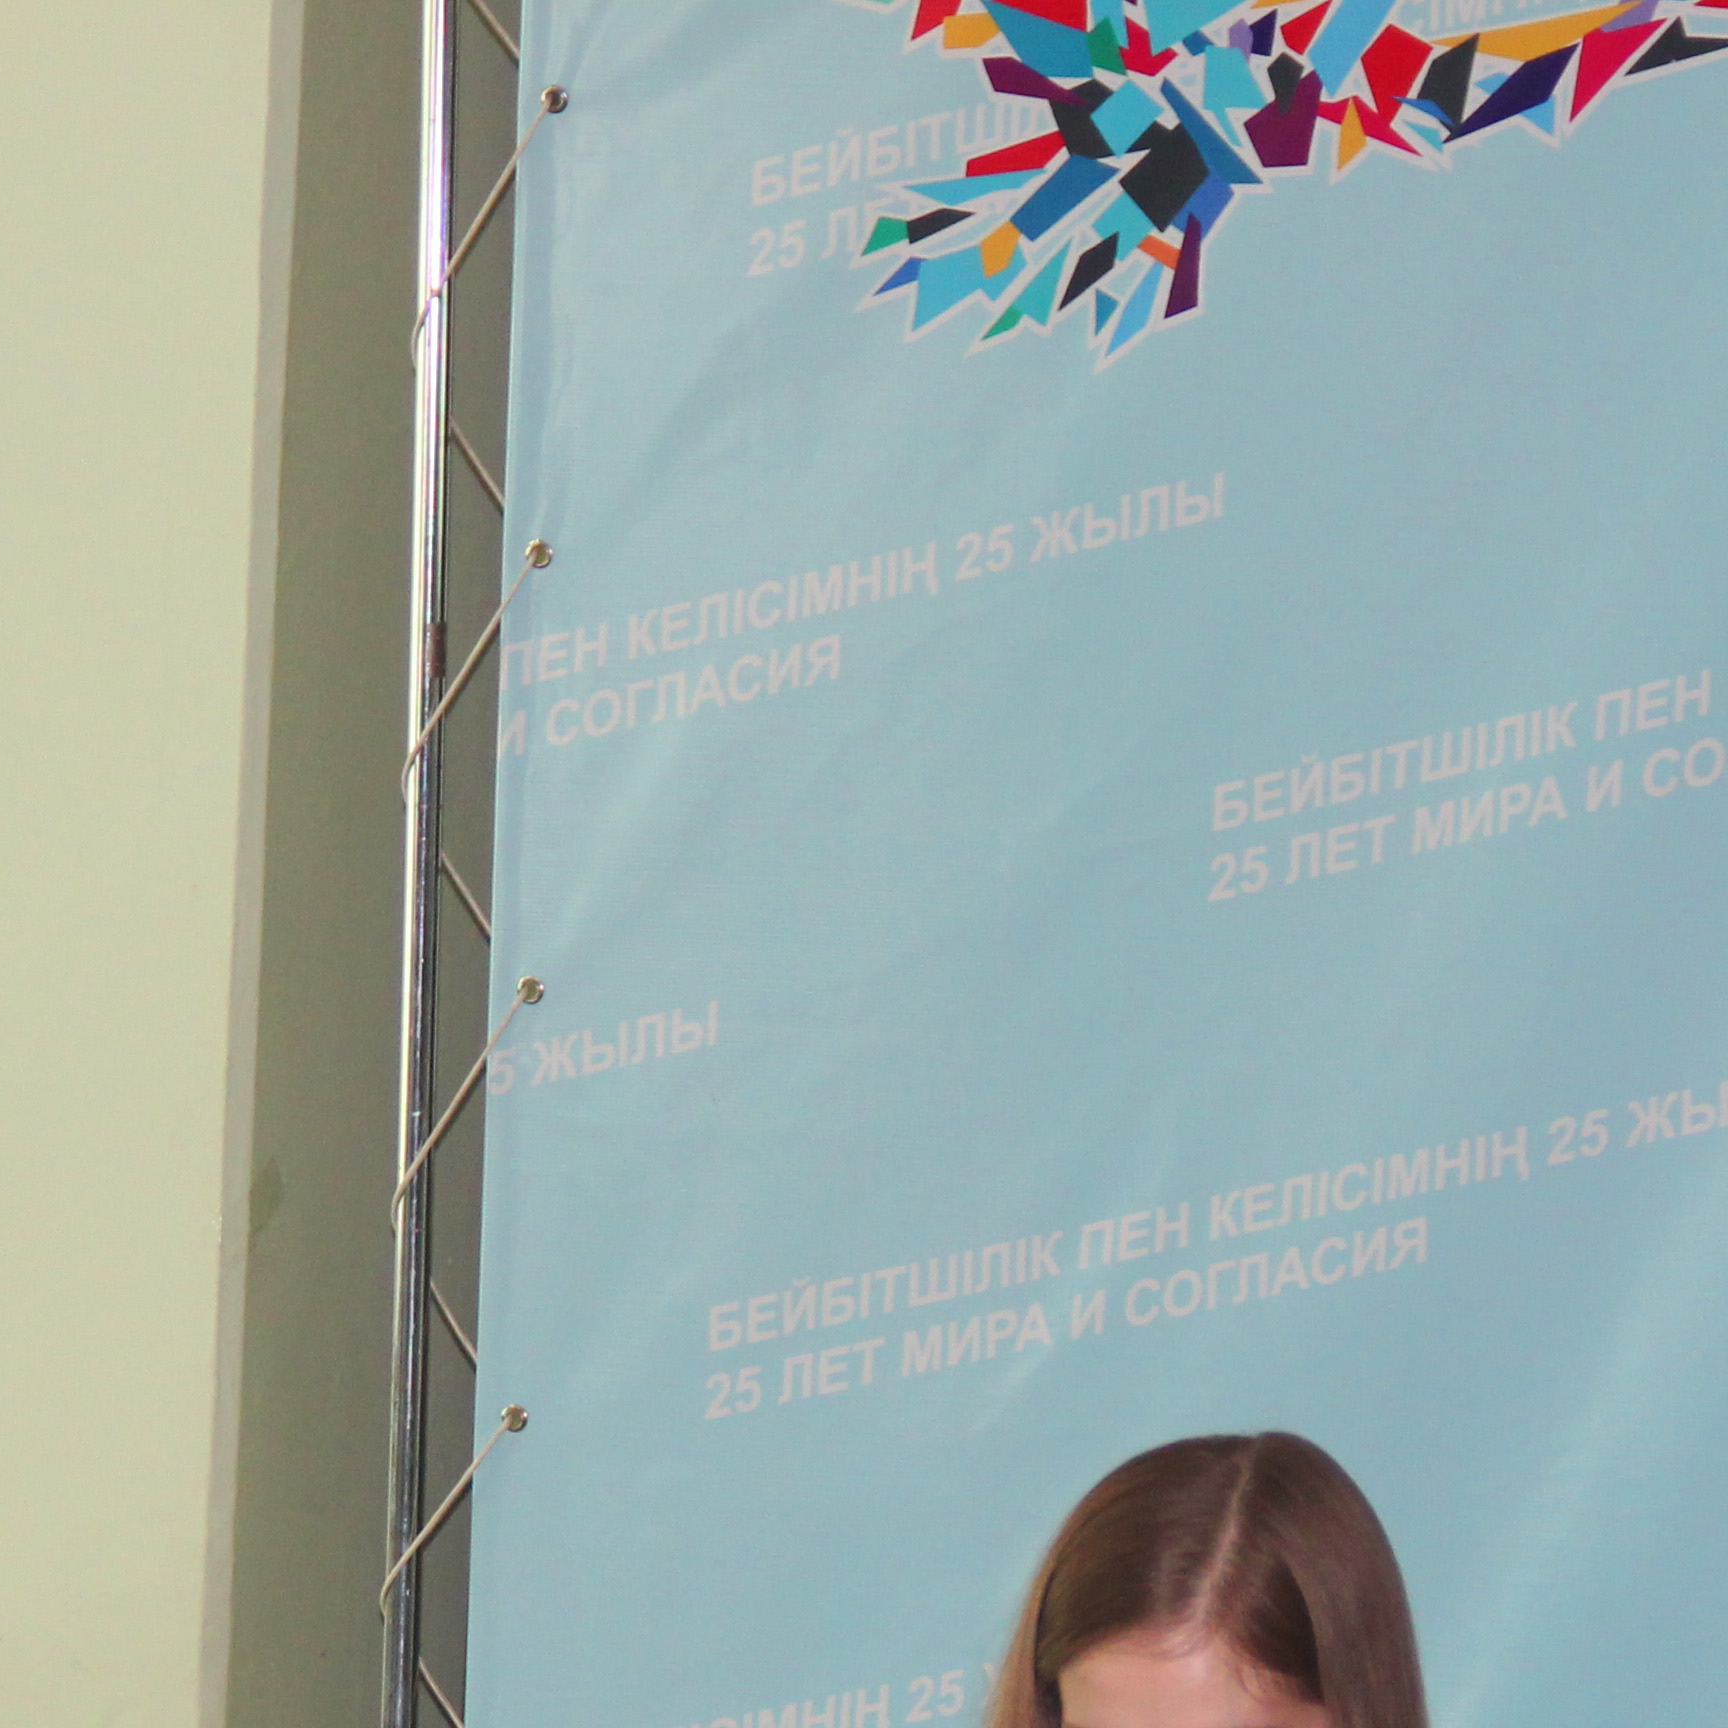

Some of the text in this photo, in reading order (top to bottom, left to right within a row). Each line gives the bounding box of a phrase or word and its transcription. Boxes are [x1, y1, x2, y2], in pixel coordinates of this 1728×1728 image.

[747, 219, 805, 276] 25
[501, 472, 1226, 692] ПЕН КЕЛІСІМНІҢ 25 ЖЫЛЫ
[548, 634, 843, 745] СОГЛАСИЯ
[1212, 701, 1578, 833] БЕЙБІТШІЛІК
[1594, 669, 1713, 741] ПЕН
[1208, 845, 1271, 902] 25
[1282, 814, 1400, 885] ЛЕТ
[1410, 776, 1568, 855] МИРА
[1585, 760, 1624, 812] И
[533, 1000, 720, 1085] ЖЫЛЫ
[708, 1231, 1064, 1353] БЕЙБІТШІЛІК
[1078, 1203, 1191, 1269] ПЕН
[1208, 1126, 1531, 1240] КЕЛІСІМНІҢ
[1546, 1109, 1611, 1166] 25
[704, 1216, 1429, 1420] 25 ЛЕТ МИРА И СОГЛАСИЯ
[906, 1670, 965, 1723] 25
